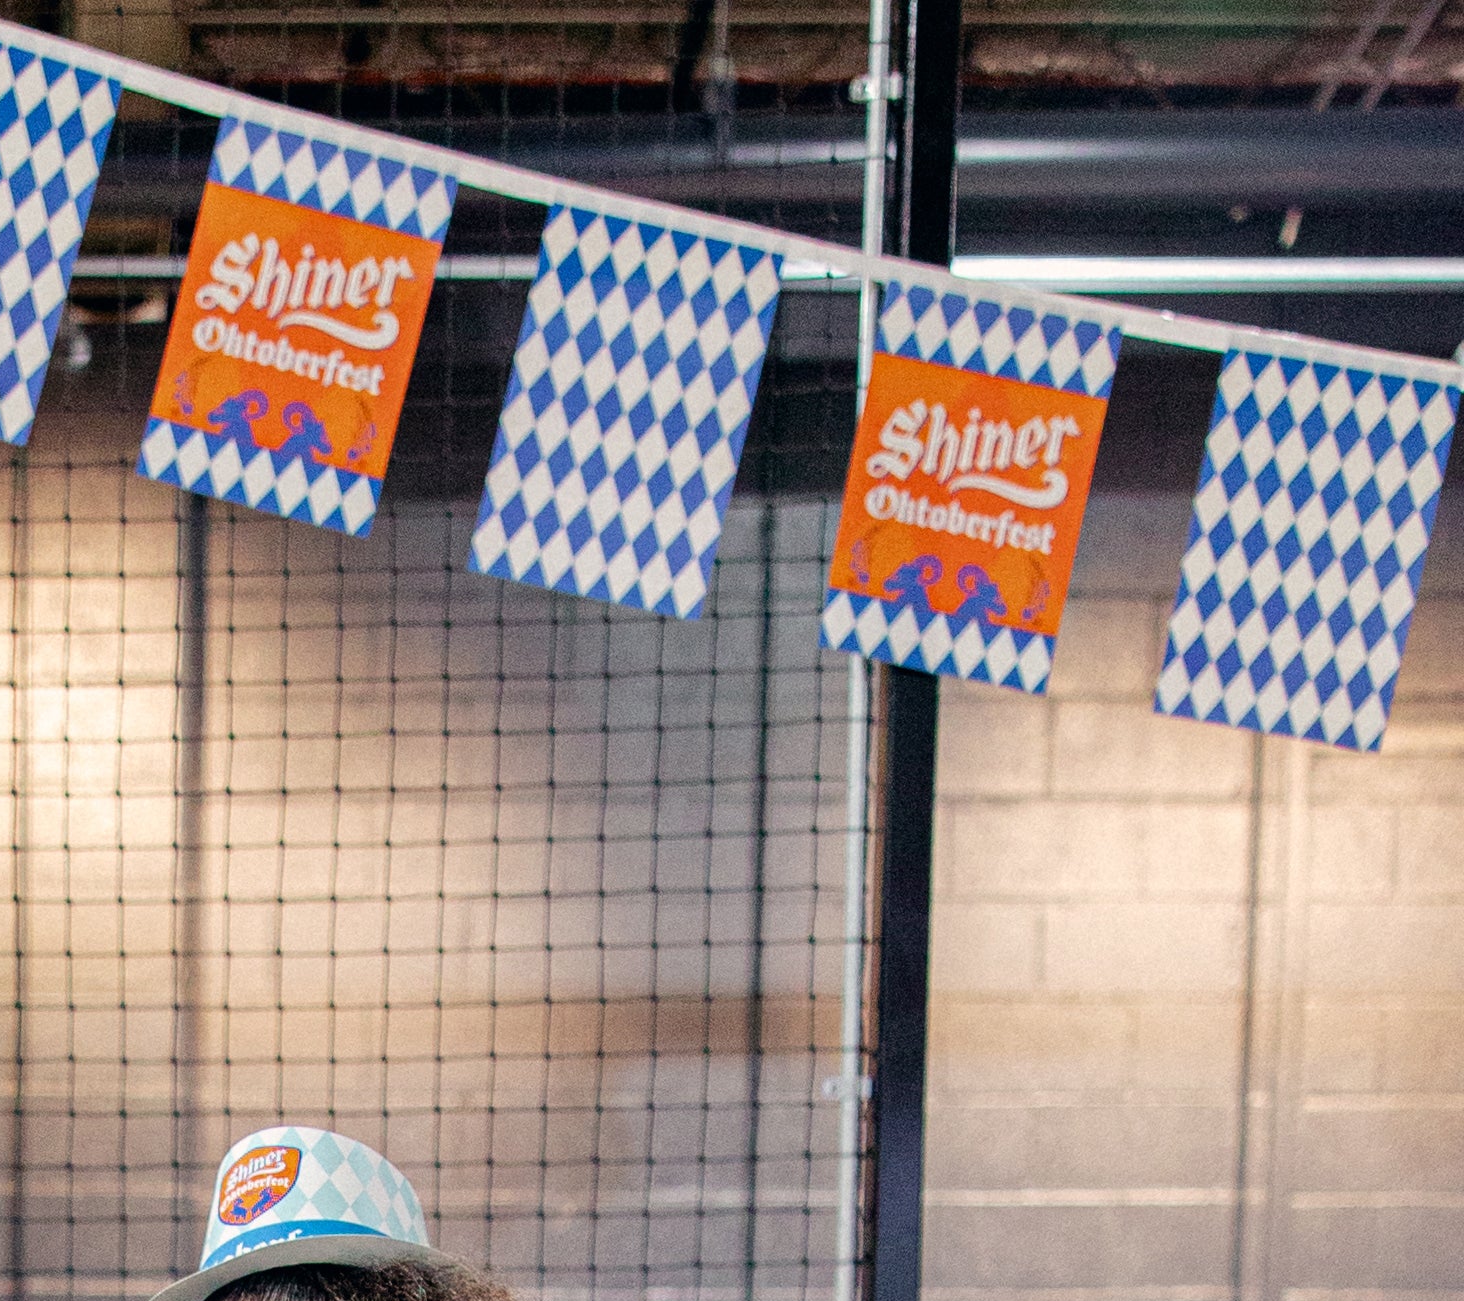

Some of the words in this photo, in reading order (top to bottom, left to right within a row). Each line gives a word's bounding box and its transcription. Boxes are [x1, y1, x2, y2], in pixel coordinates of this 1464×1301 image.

[195, 232, 415, 320] Shiner
[192, 316, 385, 396] Oktoberfest
[866, 399, 1081, 485] Shiner
[863, 484, 1056, 555] Oktoberfest
[226, 1149, 288, 1193] Shiner
